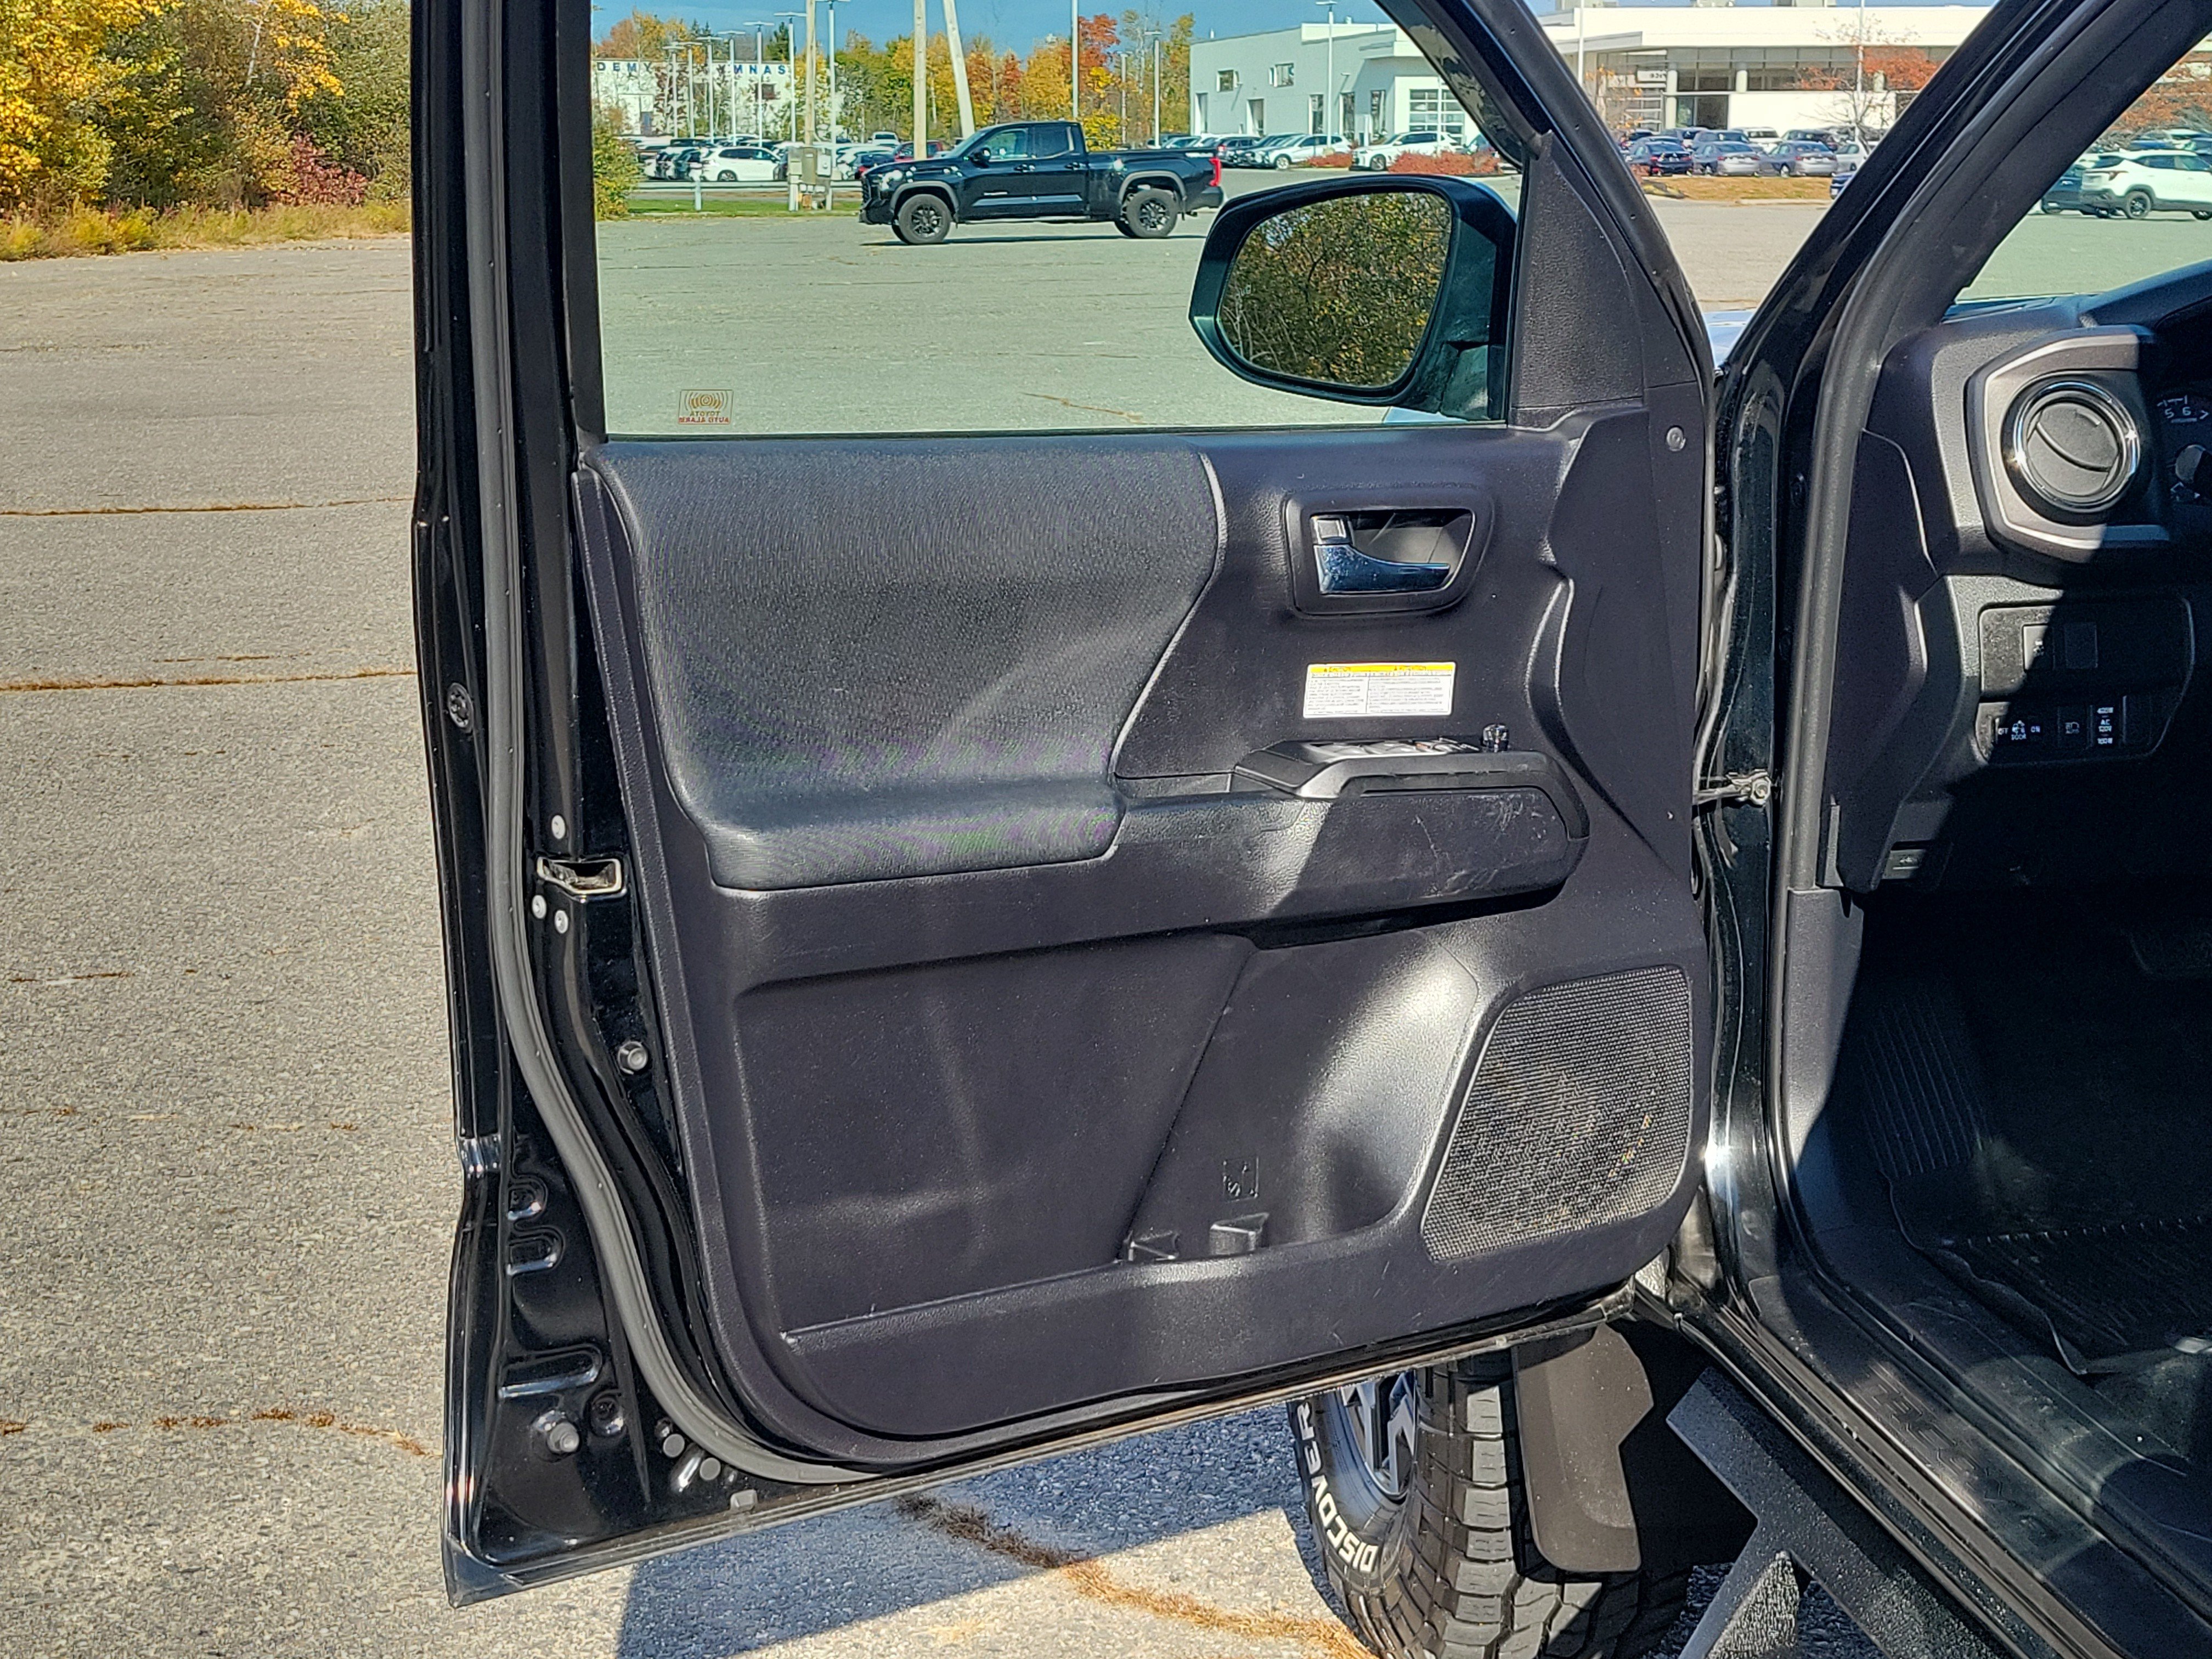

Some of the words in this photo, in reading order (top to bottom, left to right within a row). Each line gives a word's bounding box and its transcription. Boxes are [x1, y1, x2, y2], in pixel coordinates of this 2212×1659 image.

[2164, 408, 2175, 419] 5
[2182, 407, 2192, 416] 6
[1297, 1402, 1379, 1573] DISCOVER
